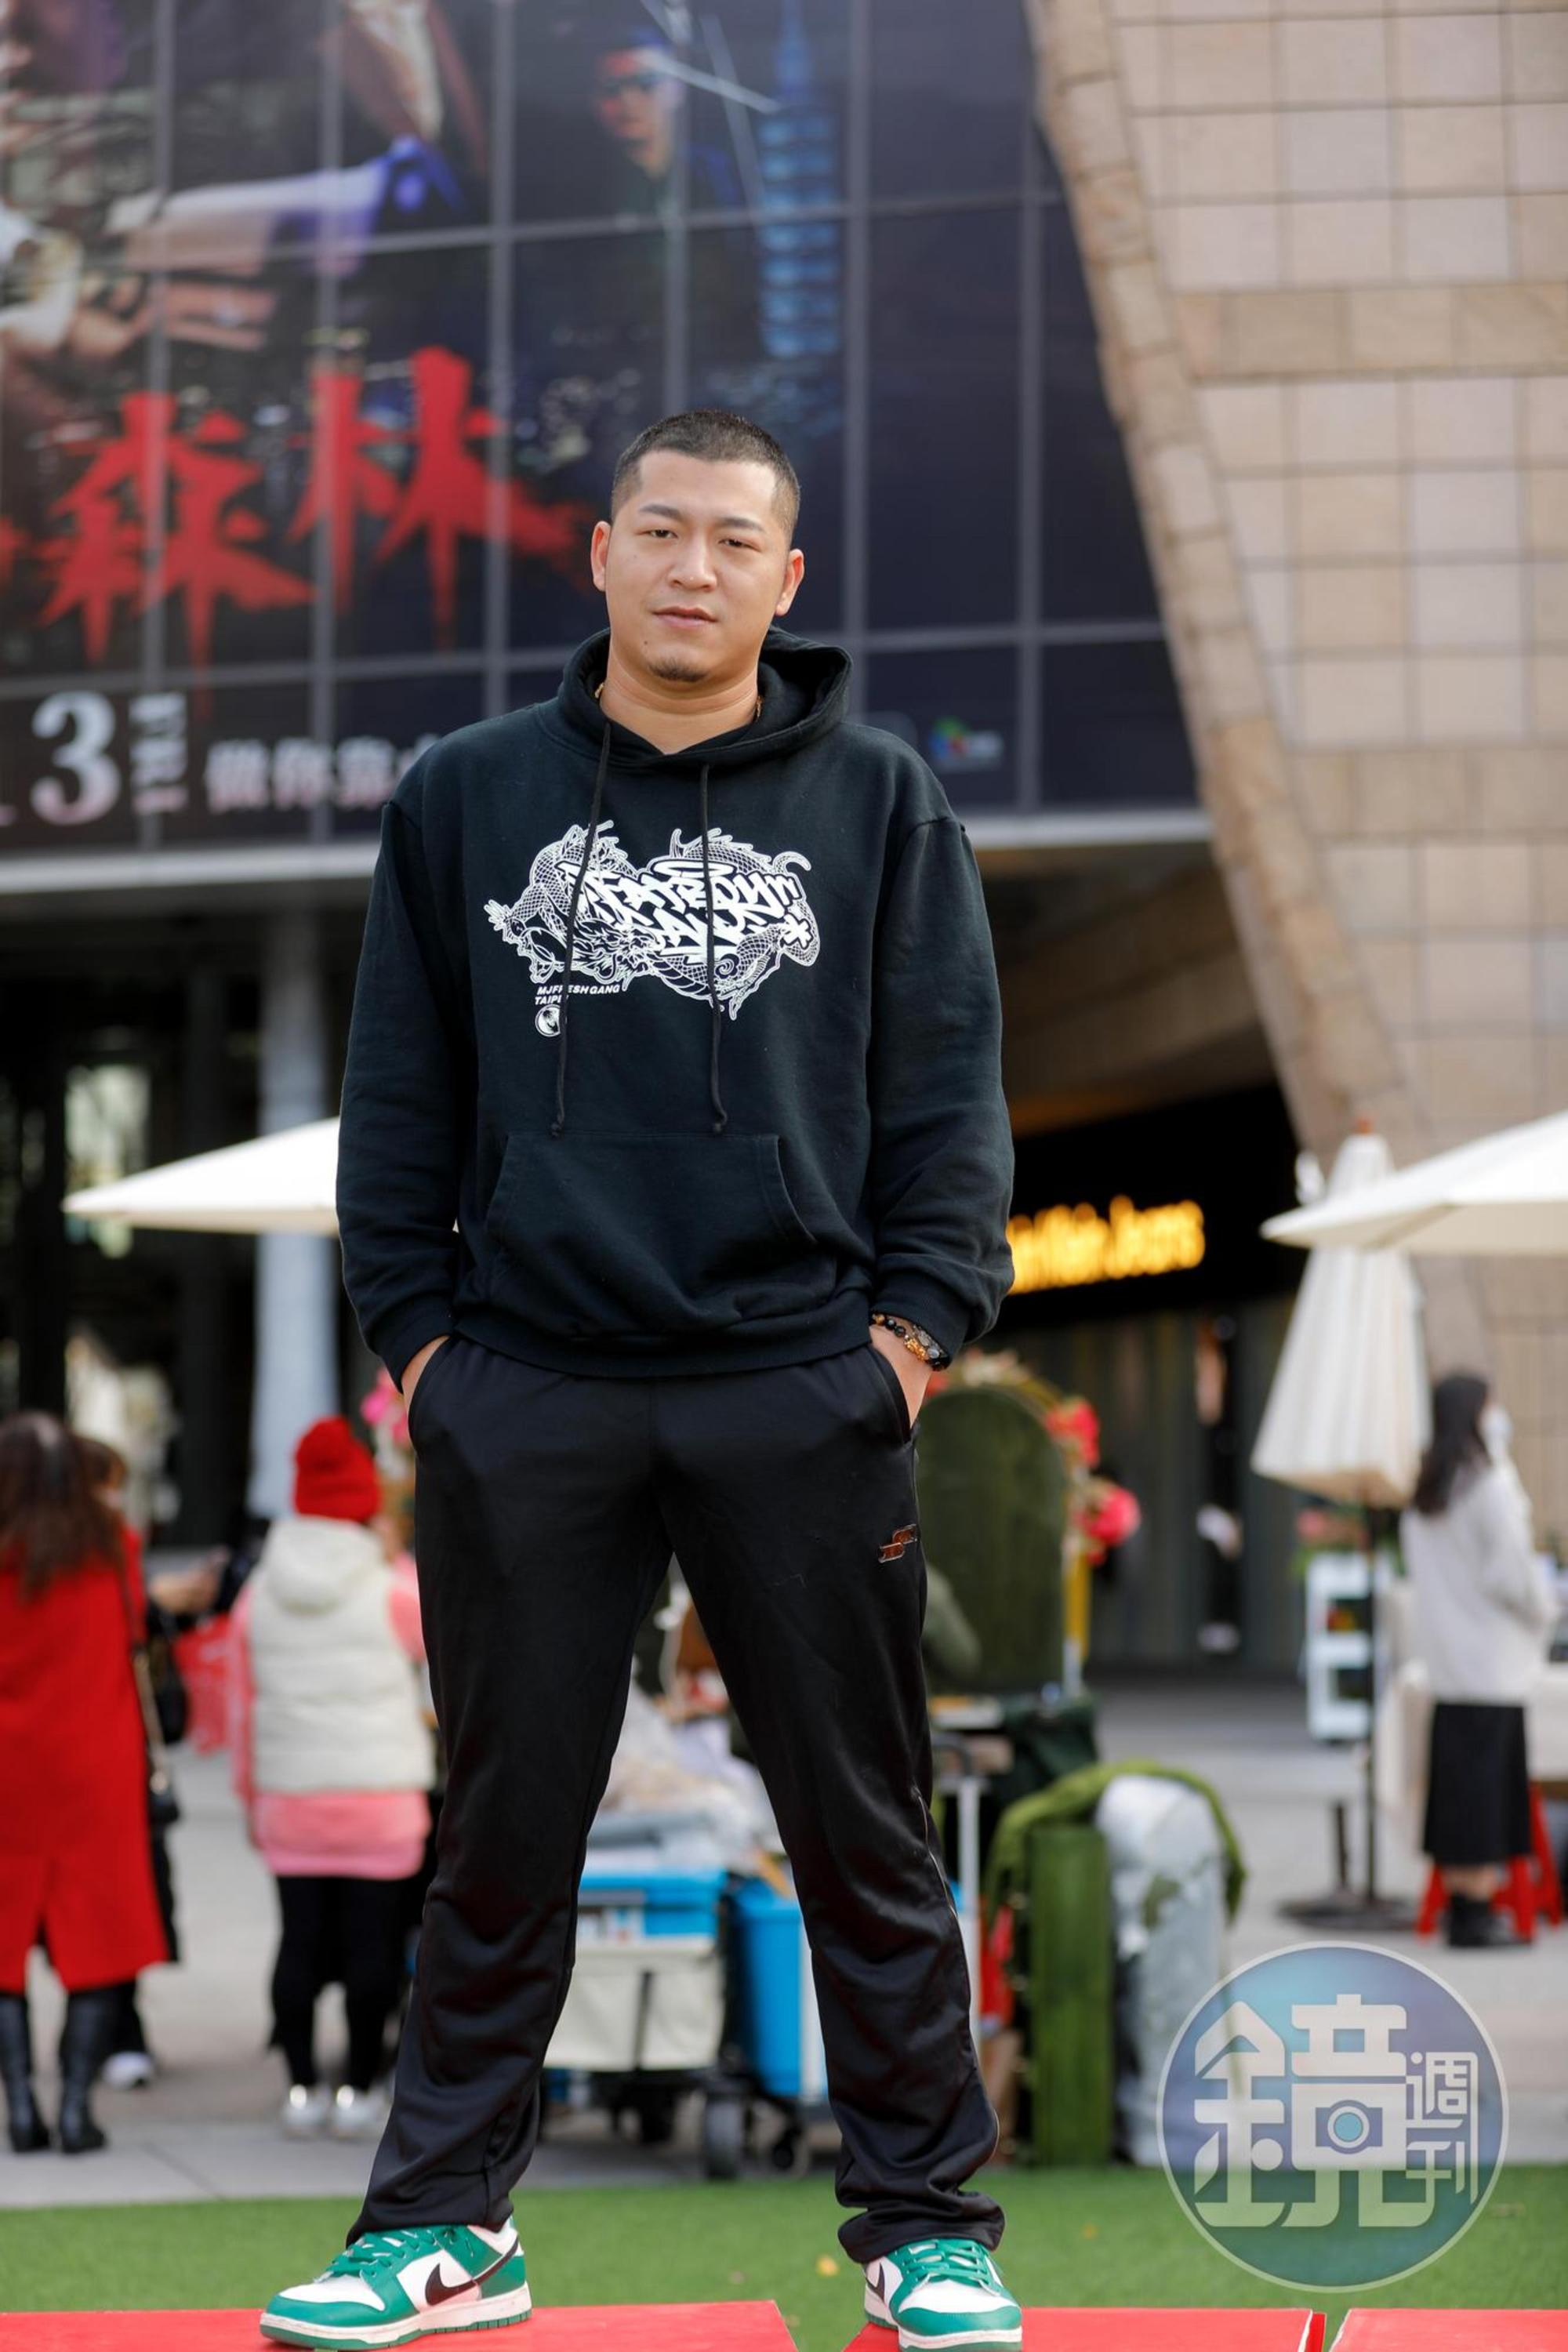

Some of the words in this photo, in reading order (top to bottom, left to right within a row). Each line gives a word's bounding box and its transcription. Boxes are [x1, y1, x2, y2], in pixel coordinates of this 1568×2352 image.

[0, 345, 580, 698] 森林
[30, 690, 122, 826] 3
[534, 994, 569, 1005] TAIP
